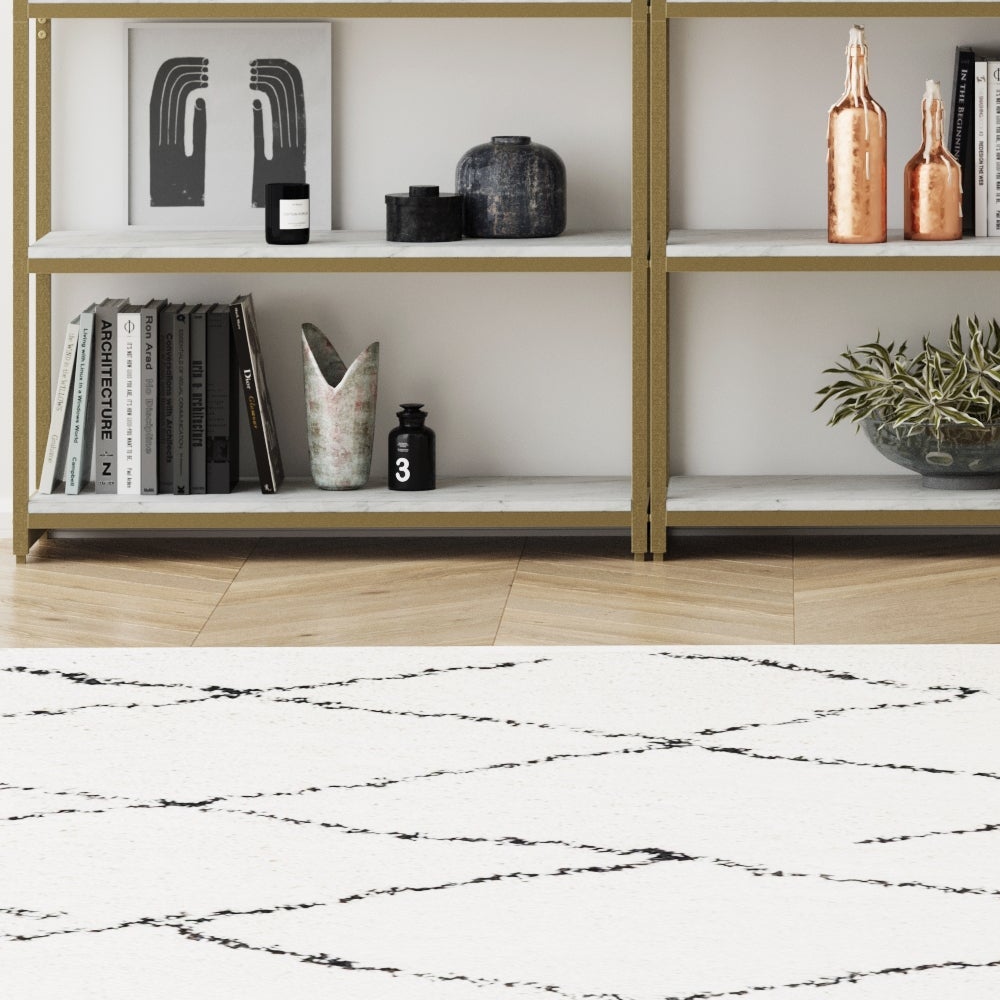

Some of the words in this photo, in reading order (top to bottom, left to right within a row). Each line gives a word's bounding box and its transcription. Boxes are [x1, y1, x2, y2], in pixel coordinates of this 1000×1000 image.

[81, 328, 89, 348] Living
[145, 315, 154, 339] Ron
[145, 343, 154, 370] Arad
[101, 320, 113, 440] ARCHITECTURE
[192, 360, 204, 378] arts
[243, 368, 252, 390] Dior
[192, 393, 205, 447] architecture
[396, 457, 410, 482] 3
